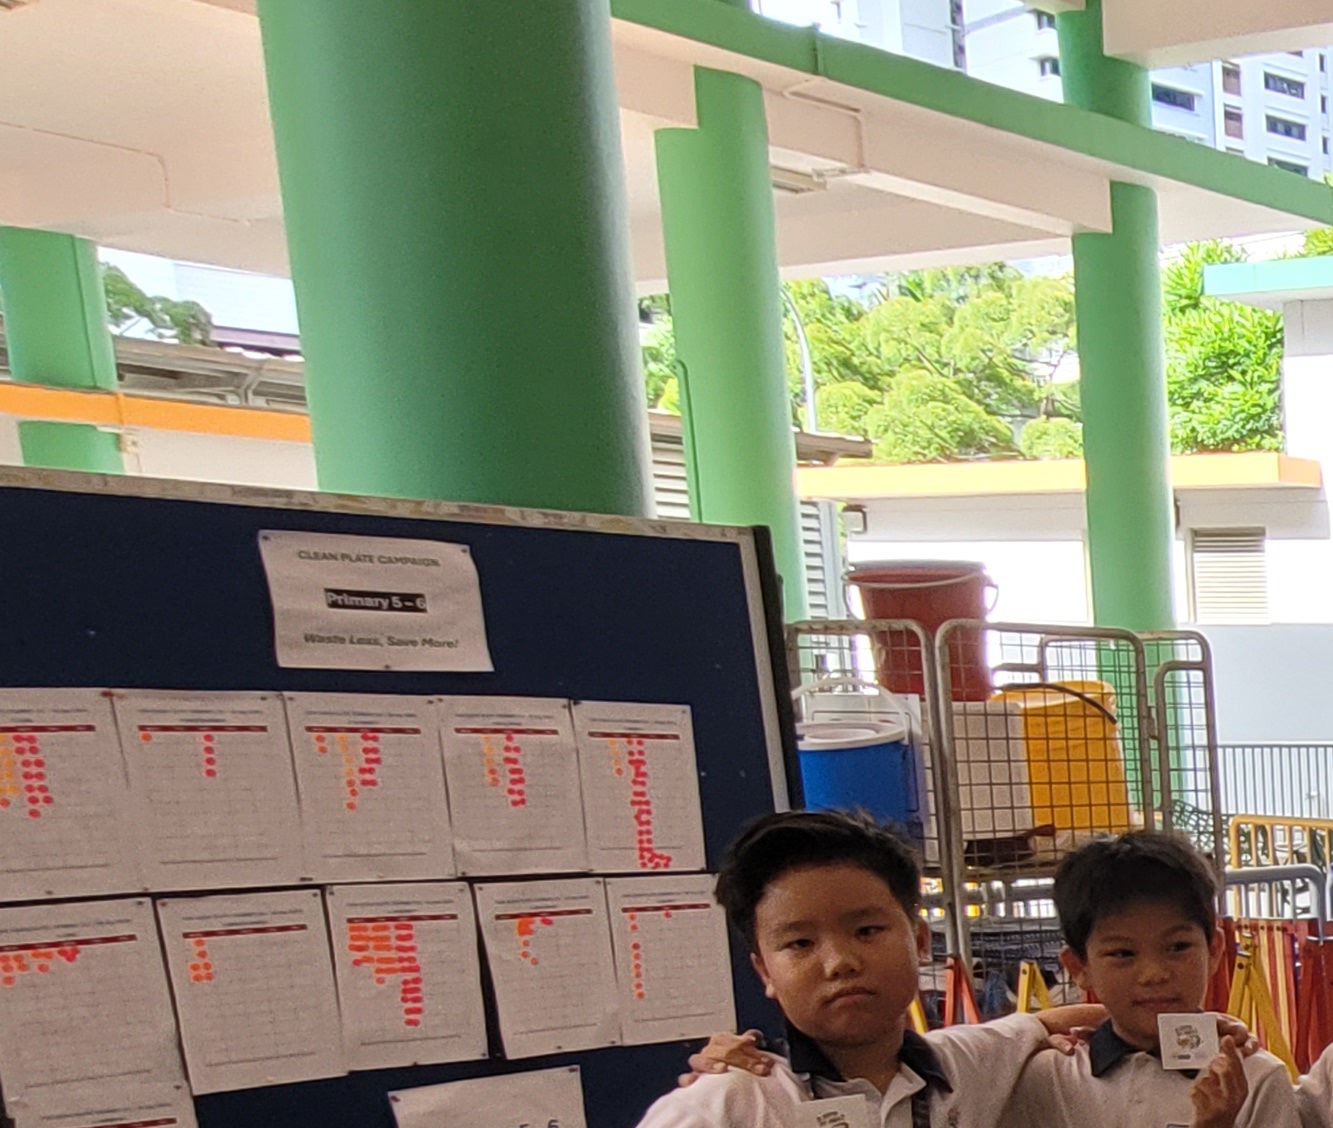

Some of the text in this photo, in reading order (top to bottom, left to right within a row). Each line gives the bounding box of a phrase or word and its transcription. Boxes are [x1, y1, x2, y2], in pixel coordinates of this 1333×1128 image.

[298, 550, 338, 562] CLEAN
[341, 552, 374, 564] PLATE
[327, 592, 389, 610] Primary
[392, 595, 402, 609] 5
[387, 636, 419, 648] Save
